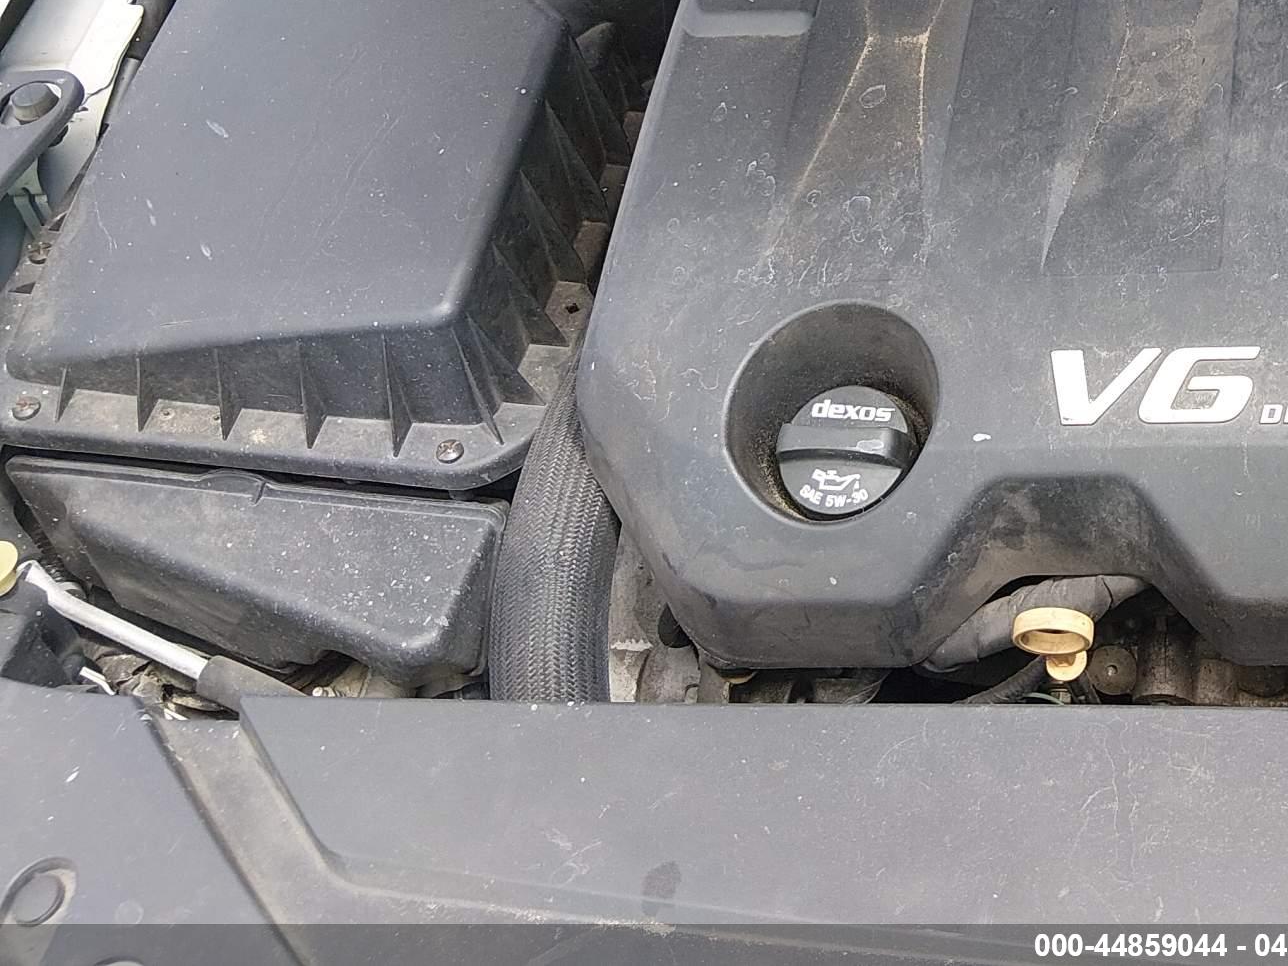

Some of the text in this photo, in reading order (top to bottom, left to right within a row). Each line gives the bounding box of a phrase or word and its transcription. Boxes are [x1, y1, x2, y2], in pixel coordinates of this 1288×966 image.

[1050, 346, 1261, 426] V6
[811, 399, 895, 422] dexos
[800, 484, 823, 505] SAE
